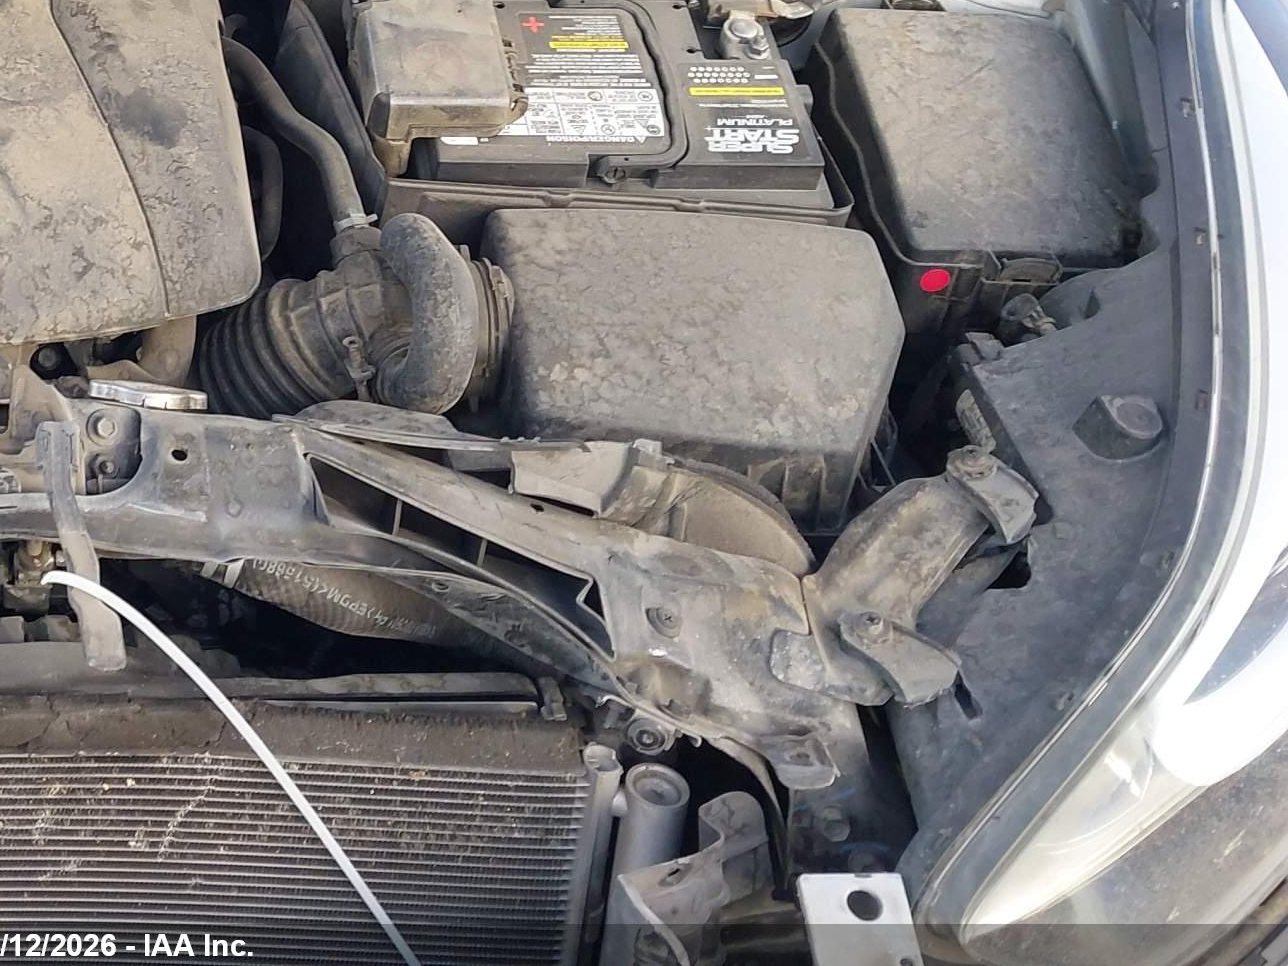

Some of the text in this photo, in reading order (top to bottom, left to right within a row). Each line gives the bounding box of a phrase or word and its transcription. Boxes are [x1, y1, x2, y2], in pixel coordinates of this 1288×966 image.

[716, 118, 793, 126] PLATINUM
[704, 129, 800, 145] START
[708, 141, 793, 154] SUPER
